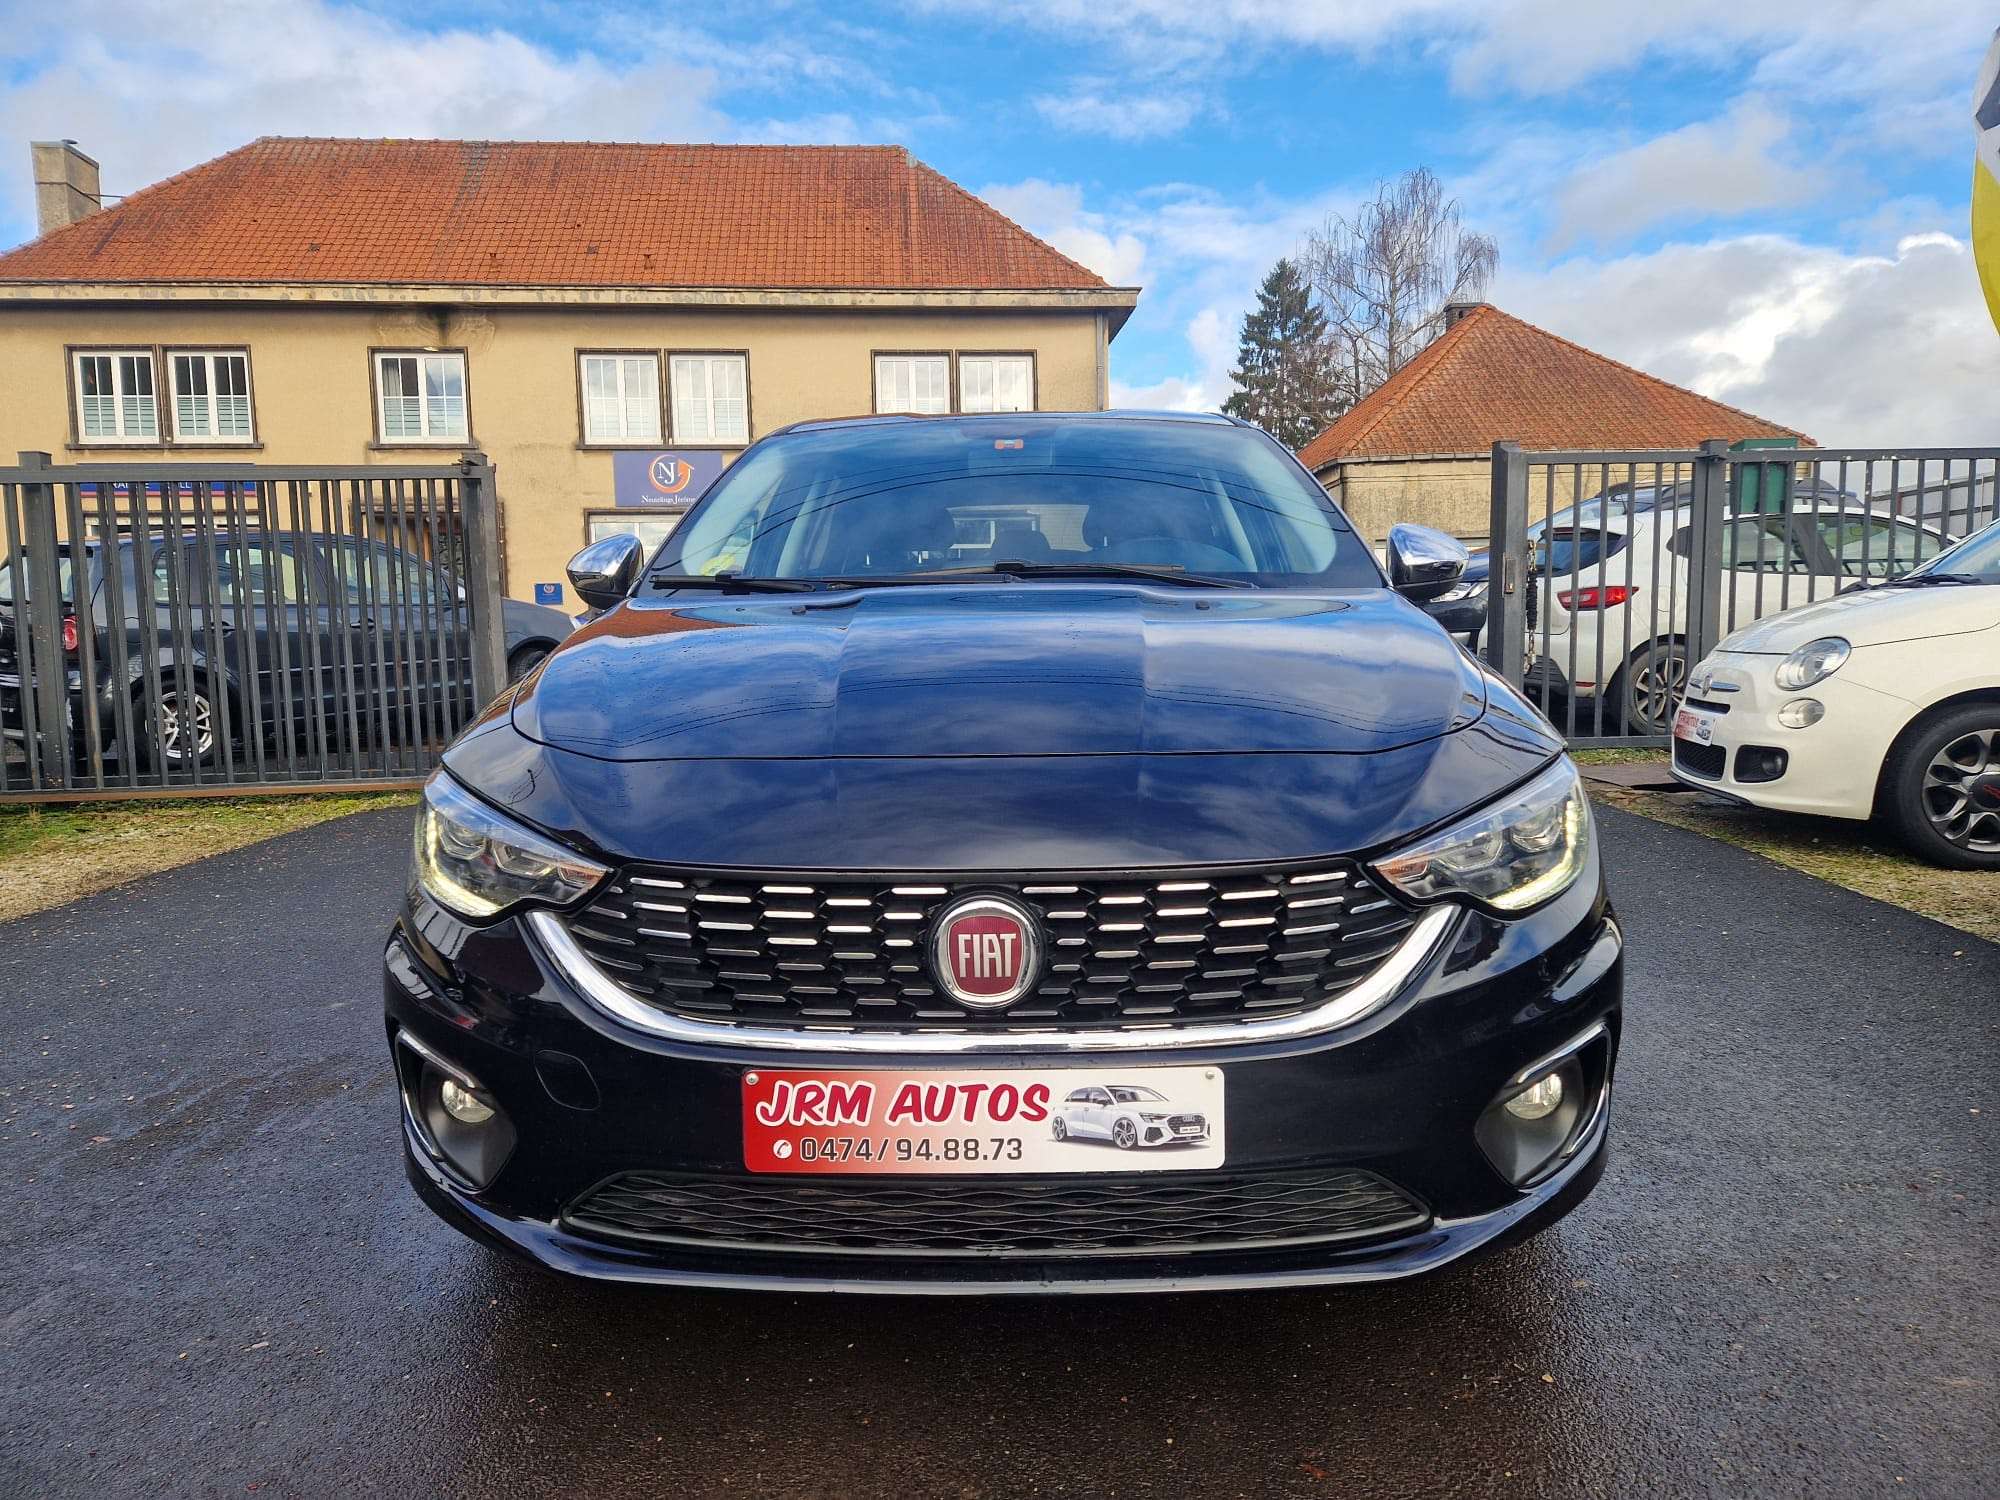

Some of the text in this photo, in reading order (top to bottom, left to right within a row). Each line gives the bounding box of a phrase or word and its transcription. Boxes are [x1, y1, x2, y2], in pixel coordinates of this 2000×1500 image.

[957, 932, 1017, 978] FIAT
[757, 1081, 1051, 1126] JRM AUTOS
